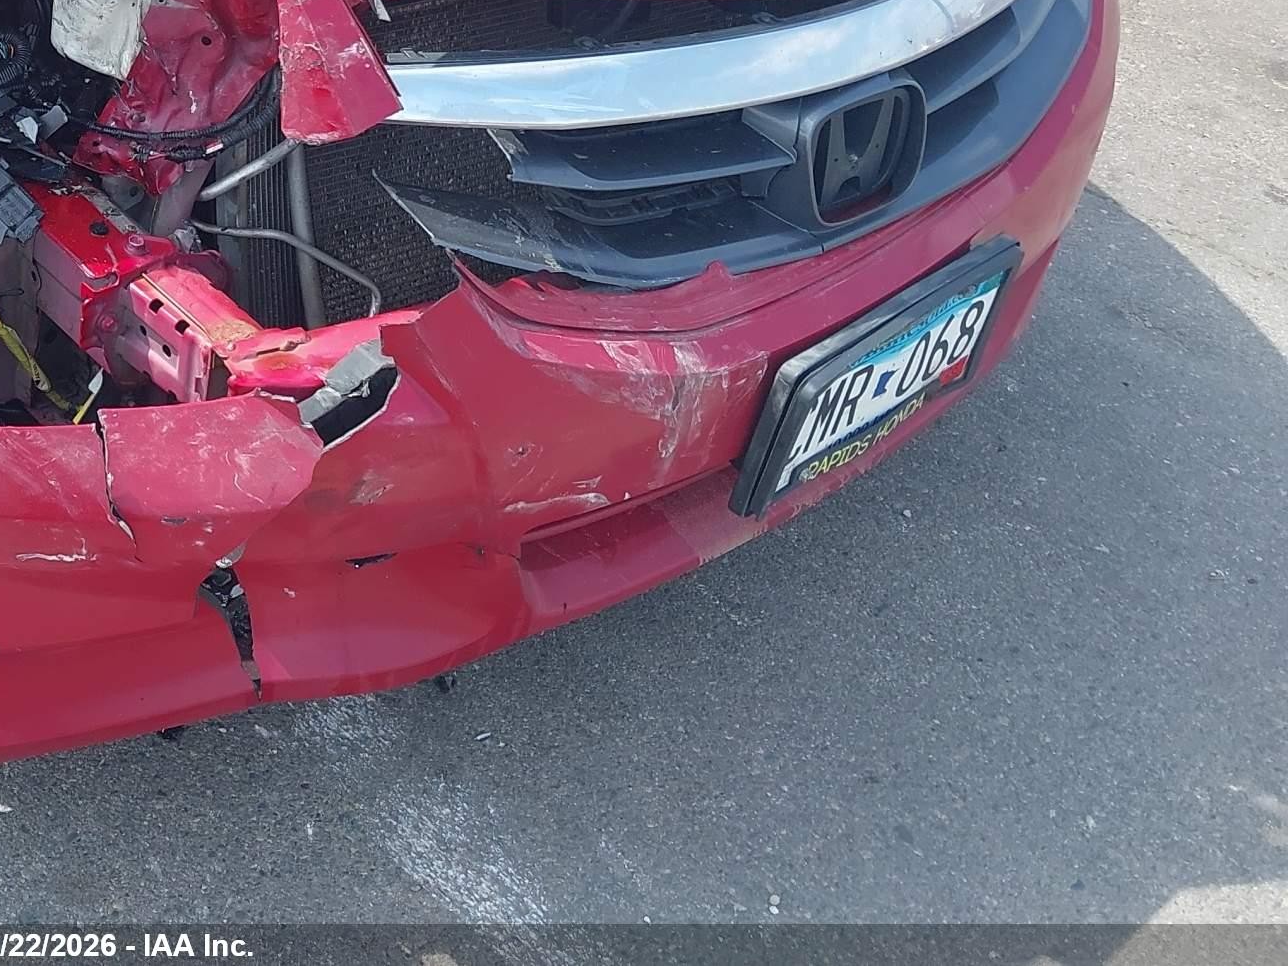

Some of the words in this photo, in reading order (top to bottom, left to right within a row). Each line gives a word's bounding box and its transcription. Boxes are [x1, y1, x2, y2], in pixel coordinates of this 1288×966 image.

[895, 300, 985, 397] 068
[807, 434, 872, 480] RAPIDS
[873, 392, 926, 446] HONDA
